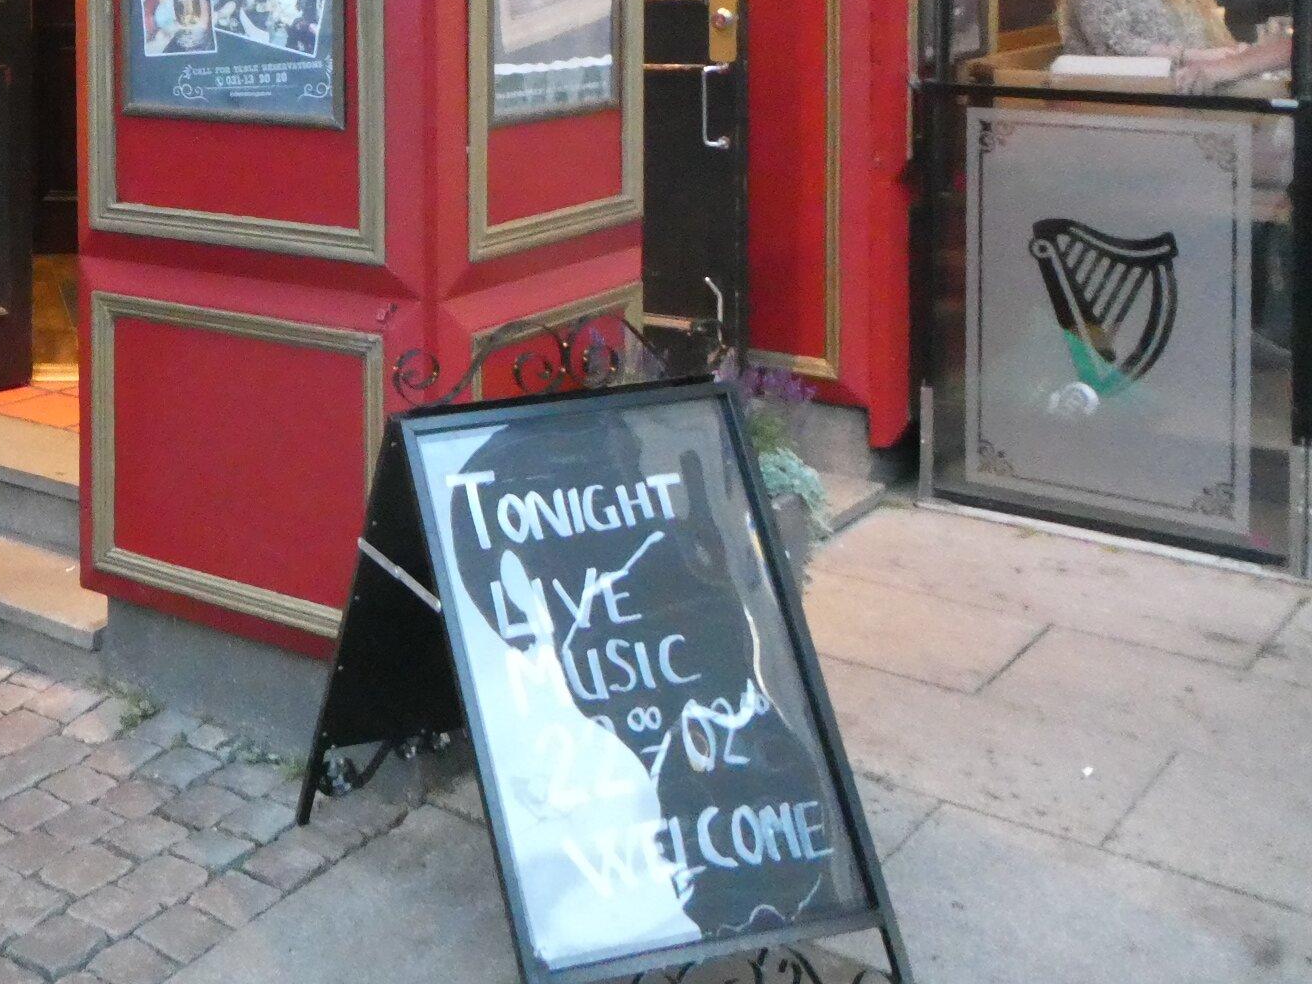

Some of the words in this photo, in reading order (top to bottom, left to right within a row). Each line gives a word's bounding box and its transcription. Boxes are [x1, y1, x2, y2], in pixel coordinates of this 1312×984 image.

[215, 66, 231, 75] FOR
[233, 64, 259, 74] TABLE
[262, 60, 323, 71] RESERVATIONS
[445, 470, 682, 550] TONIGHT
[490, 567, 643, 640] LIVE
[562, 800, 835, 899] WELCOME
